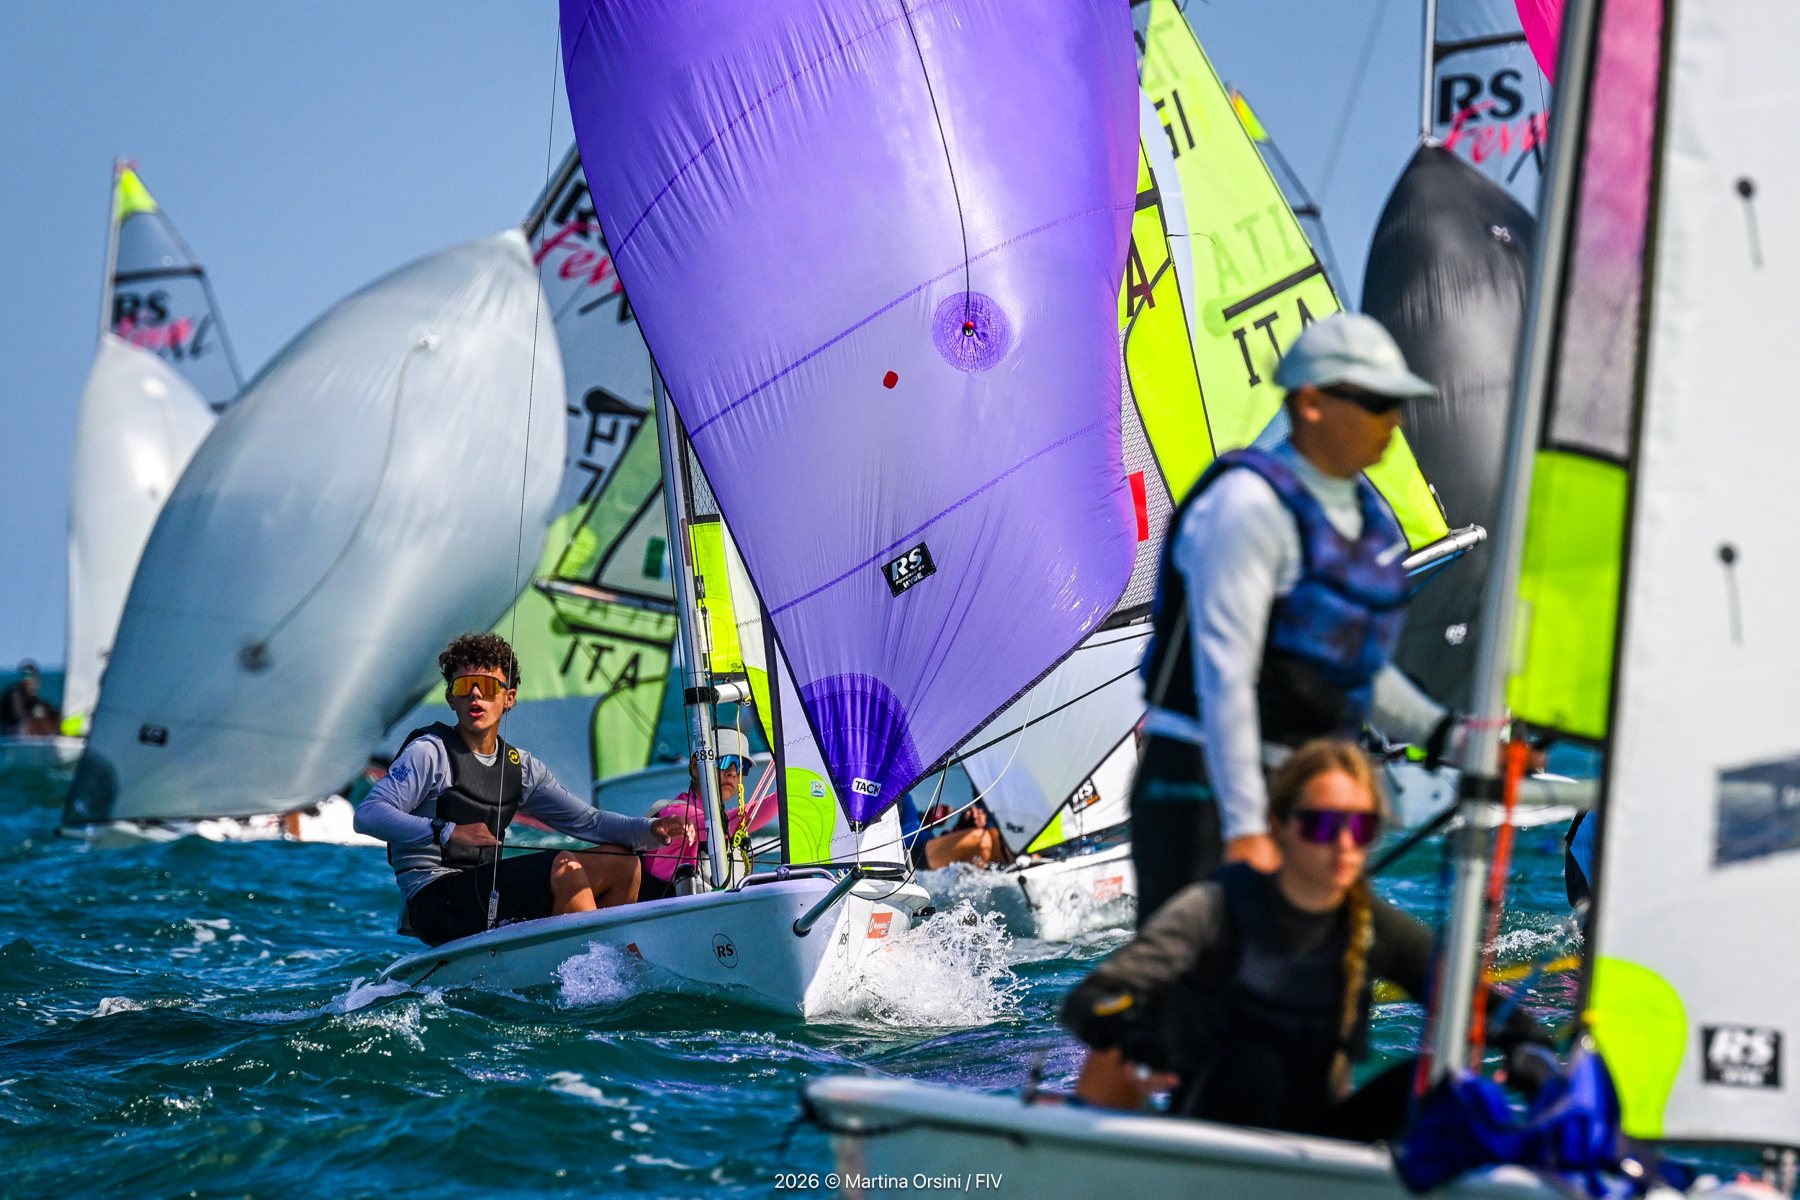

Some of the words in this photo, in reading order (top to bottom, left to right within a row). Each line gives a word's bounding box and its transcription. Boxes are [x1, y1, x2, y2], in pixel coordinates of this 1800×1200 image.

[1438, 68, 1524, 125] RS
[554, 180, 609, 253] R
[533, 219, 625, 294] Fev
[112, 290, 169, 326] RS
[891, 547, 923, 582] RS
[560, 636, 640, 690] ITA
[855, 780, 881, 795] TACK
[717, 943, 735, 959] RS
